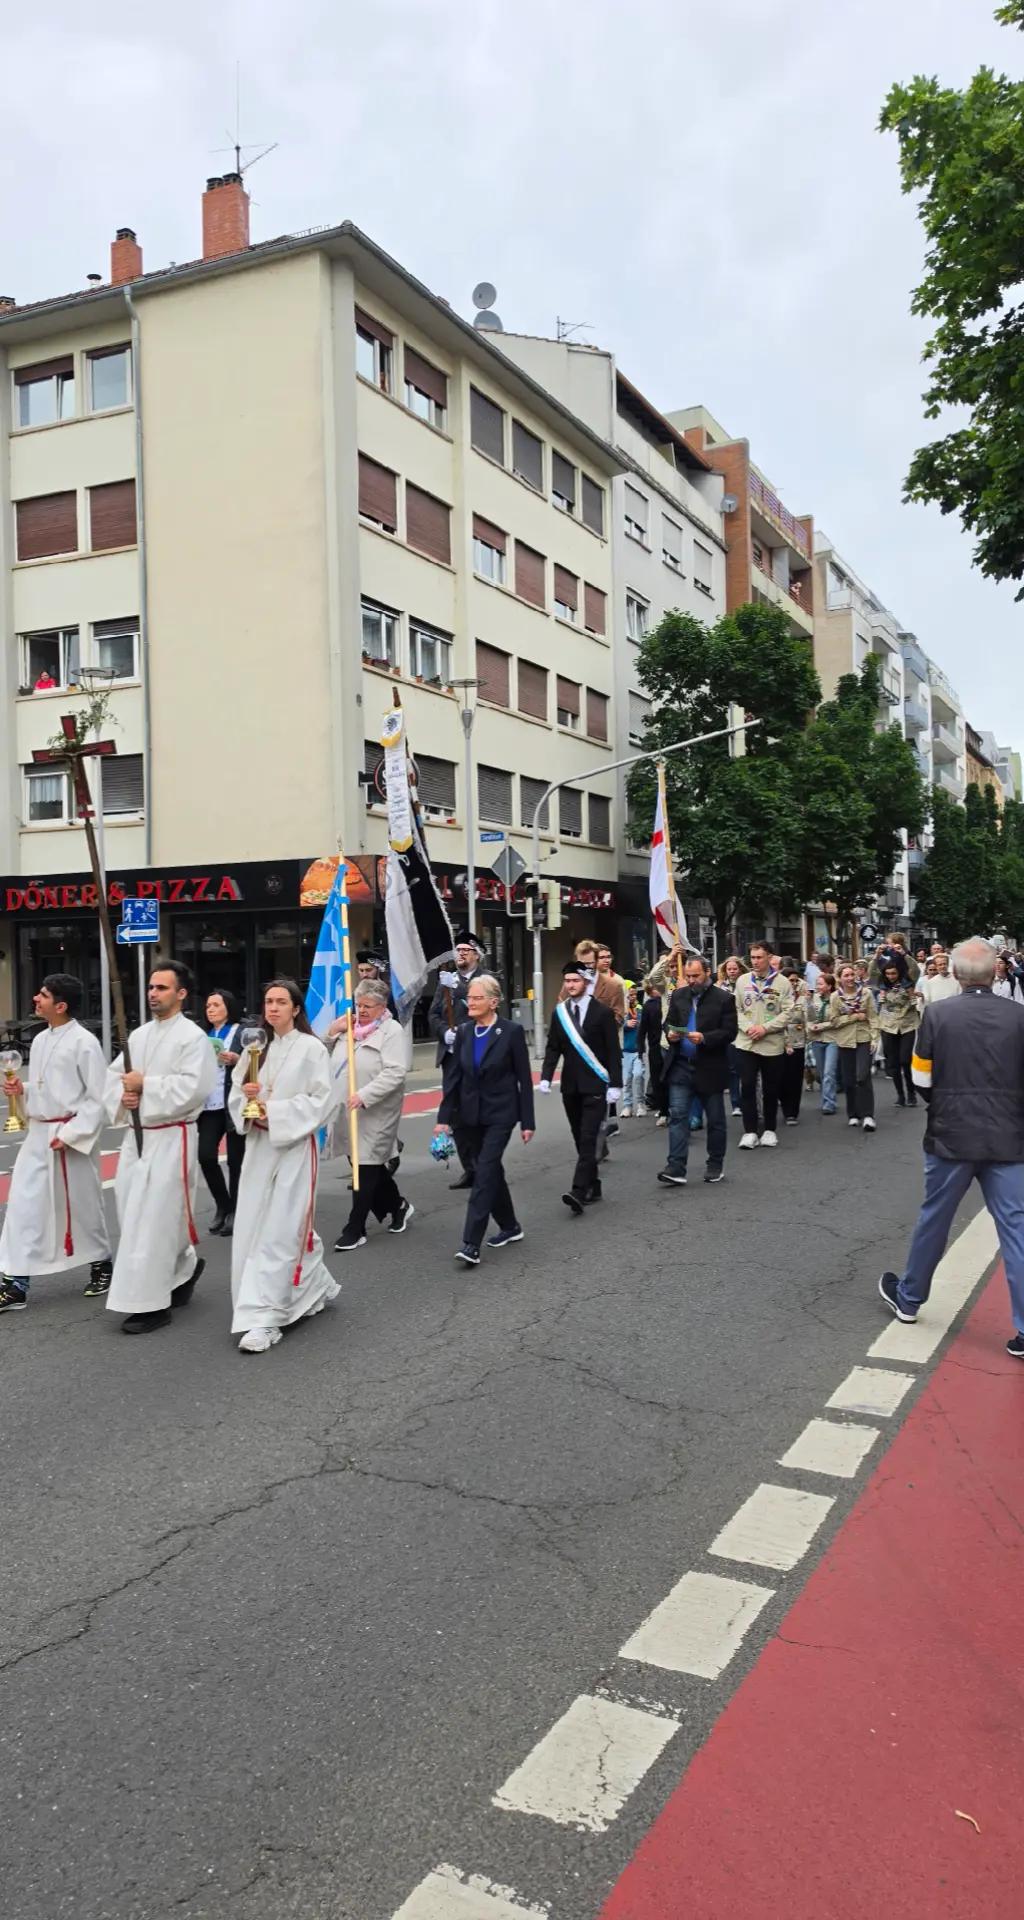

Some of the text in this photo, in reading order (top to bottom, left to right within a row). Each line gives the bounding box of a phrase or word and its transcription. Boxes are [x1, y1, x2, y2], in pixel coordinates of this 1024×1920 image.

[6, 880, 98, 911] DÖNER
[108, 881, 126, 906] &
[137, 876, 240, 901] PIZZA
